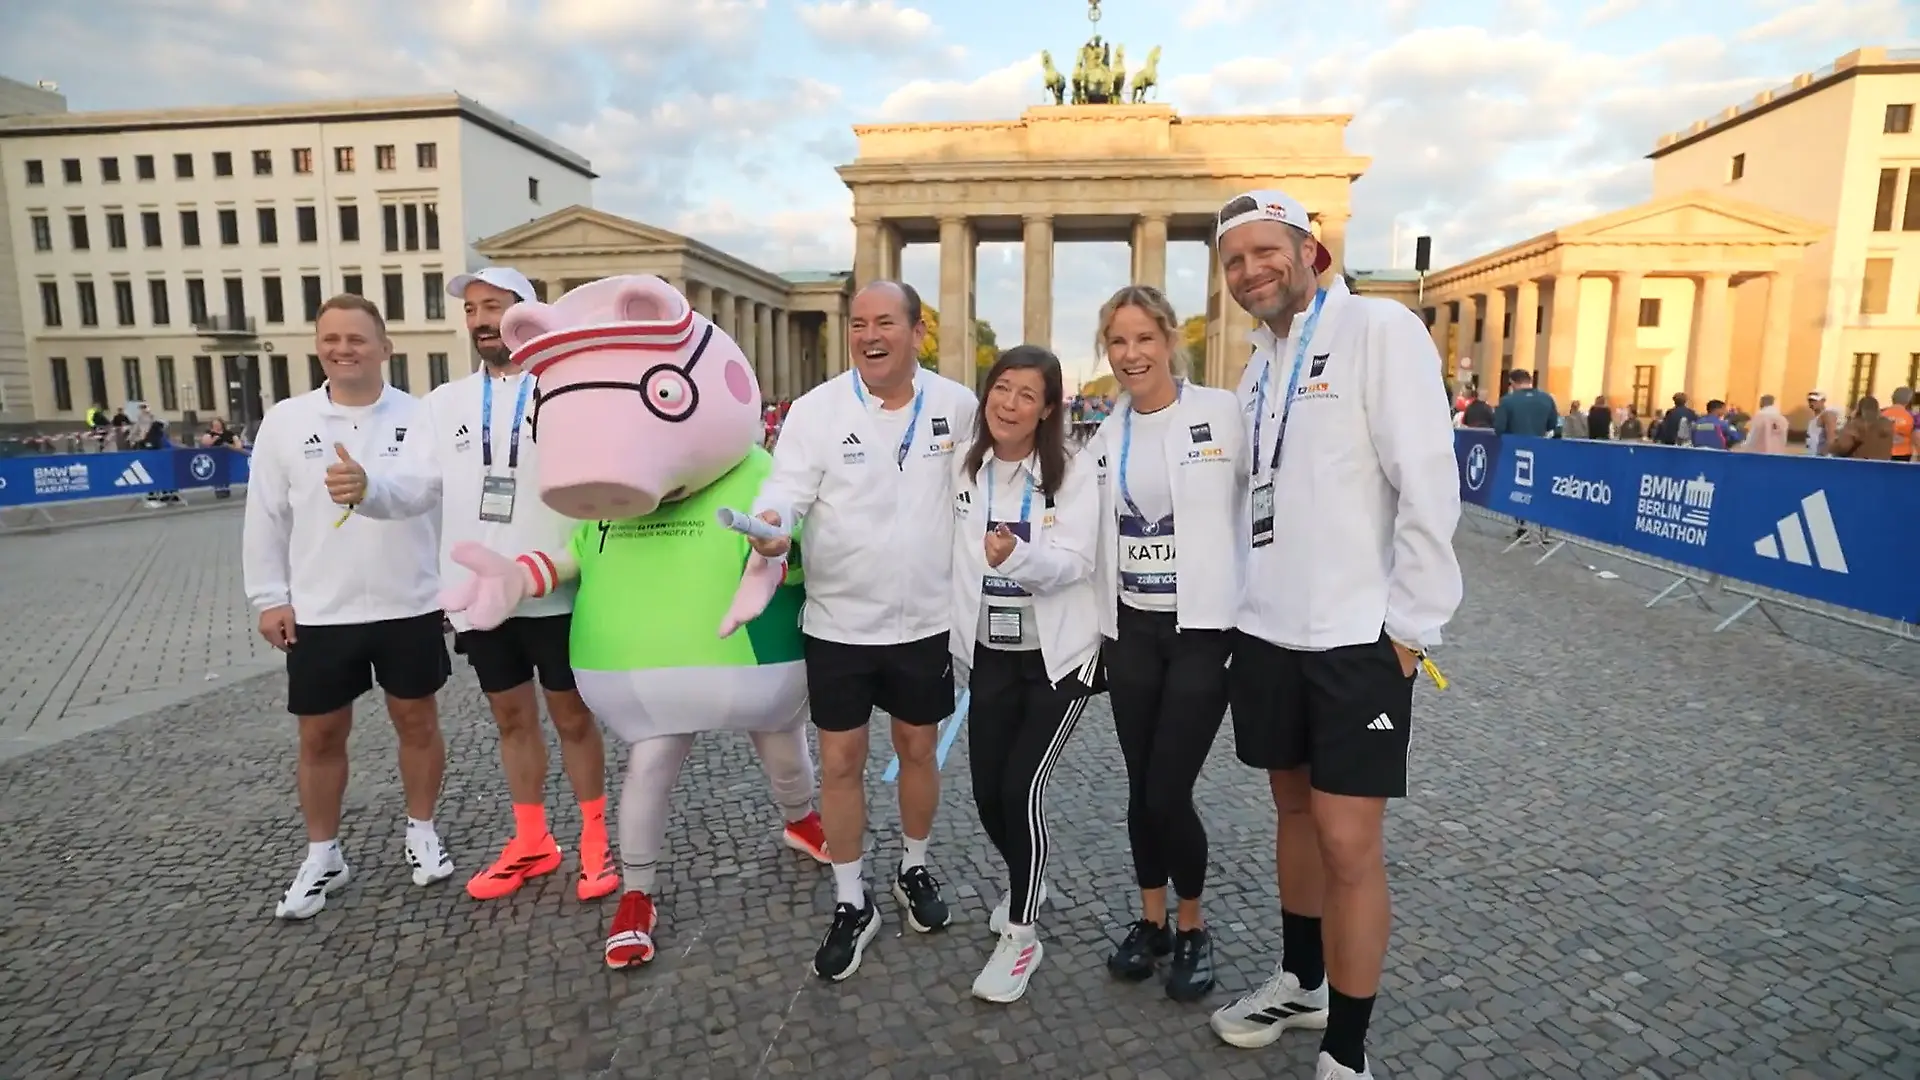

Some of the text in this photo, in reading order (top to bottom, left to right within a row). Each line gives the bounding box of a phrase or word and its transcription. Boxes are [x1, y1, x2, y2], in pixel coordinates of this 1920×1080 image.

[33, 466, 69, 478] BMW
[1551, 475, 1612, 505] zalando
[1640, 474, 1686, 502] BMW
[1637, 498, 1682, 521] BERLIN
[1635, 515, 1707, 547] MARATHON
